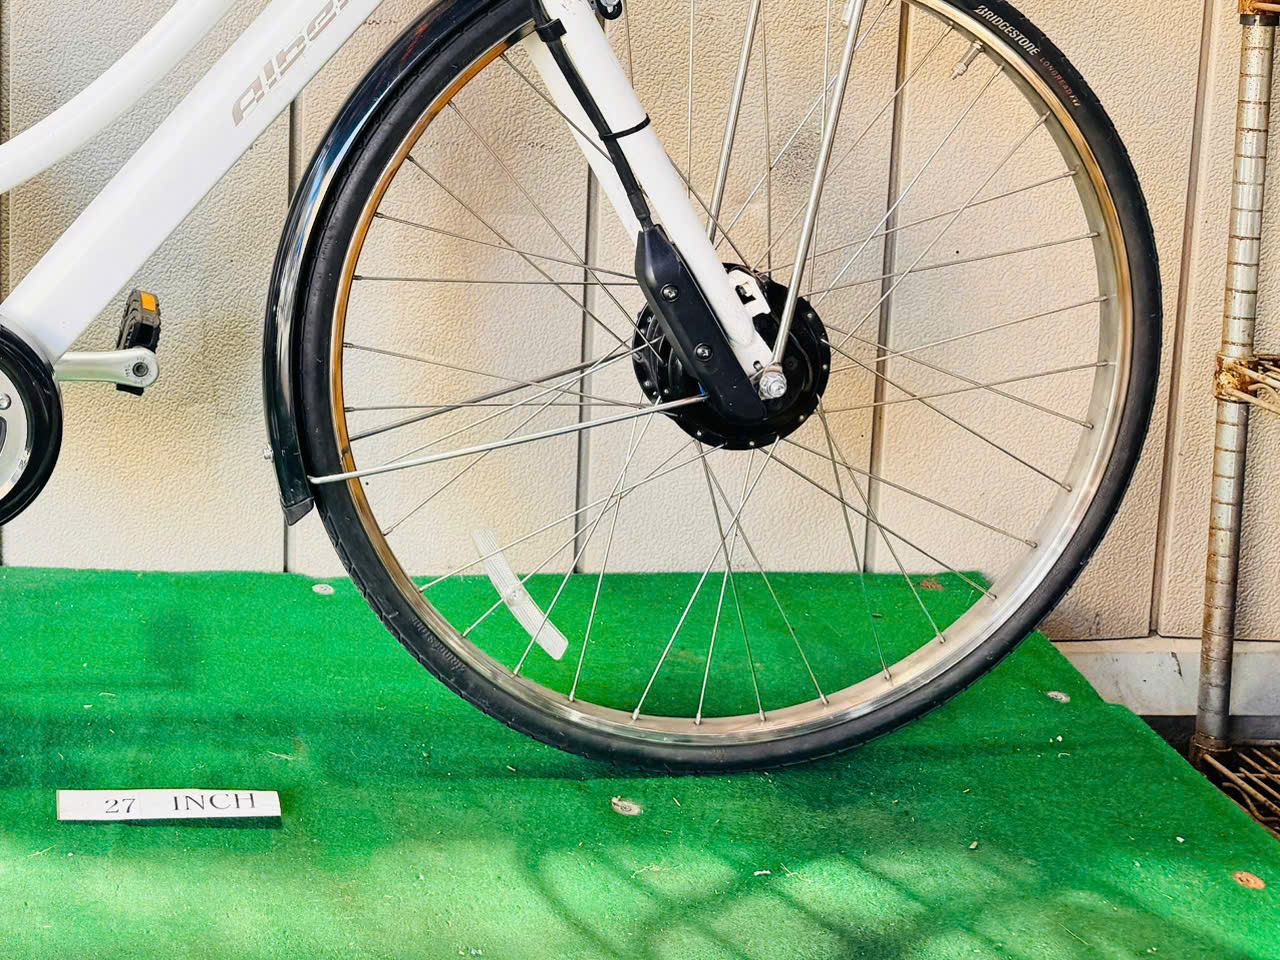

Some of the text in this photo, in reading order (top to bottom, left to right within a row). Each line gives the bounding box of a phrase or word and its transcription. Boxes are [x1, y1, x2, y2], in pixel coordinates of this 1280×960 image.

[973, 4, 1040, 56] BRIDGESTONE
[104, 792, 256, 814] 27 INCH
